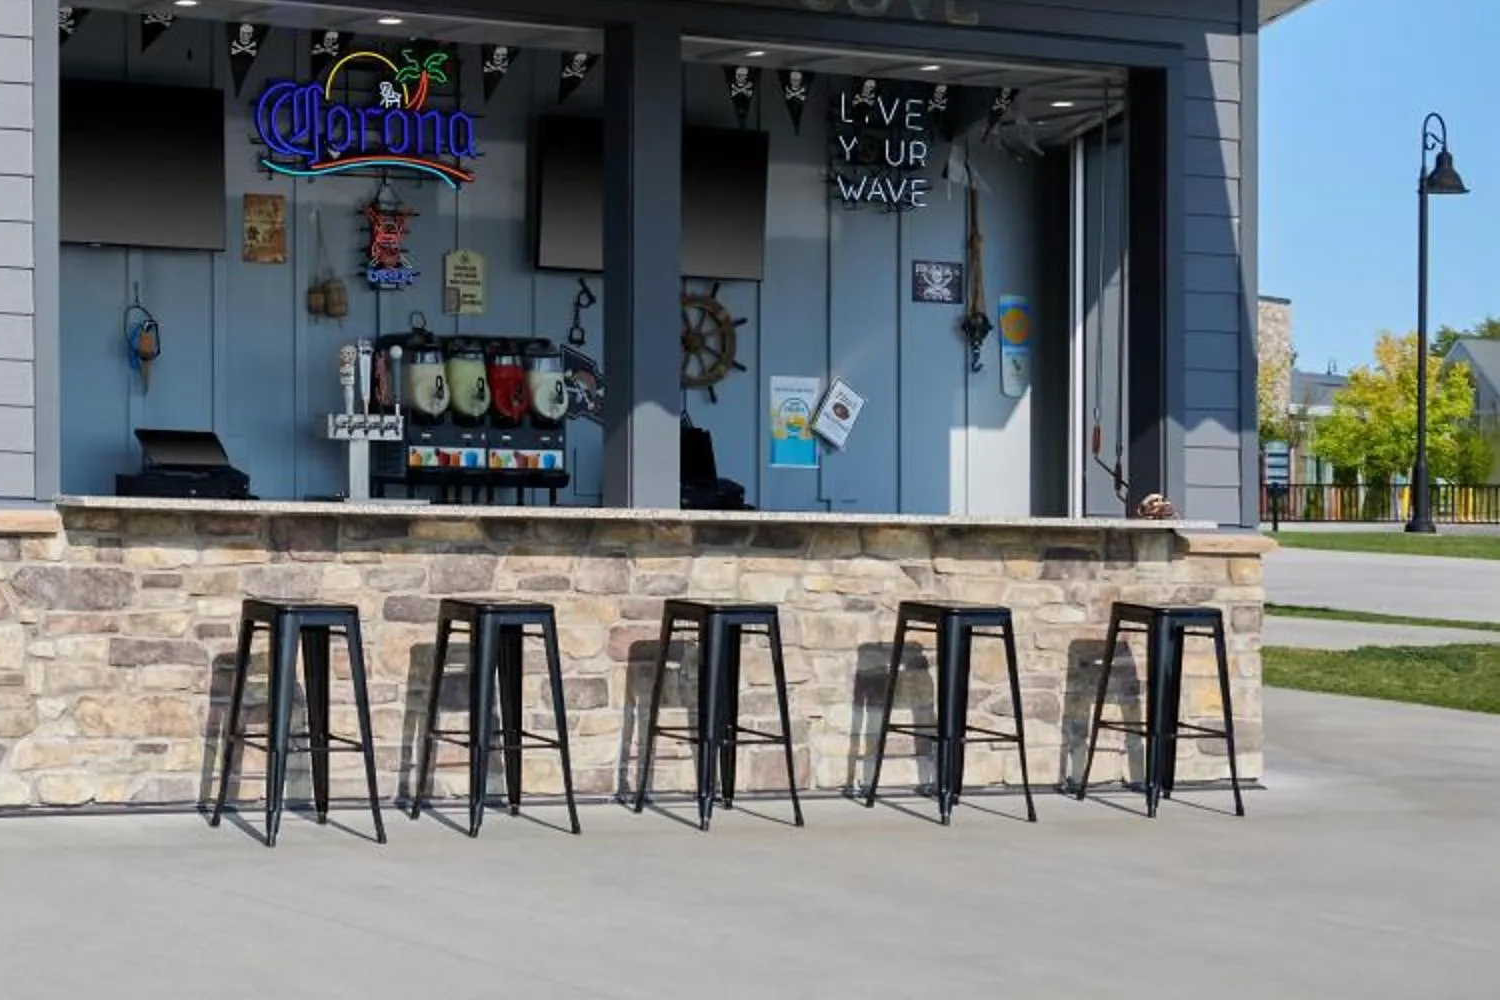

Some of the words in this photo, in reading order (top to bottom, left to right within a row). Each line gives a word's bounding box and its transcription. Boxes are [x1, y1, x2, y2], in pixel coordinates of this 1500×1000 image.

[255, 80, 480, 166] Corona
[840, 91, 924, 131] LVE
[839, 135, 927, 167] YUR
[837, 175, 928, 207] WAVE
